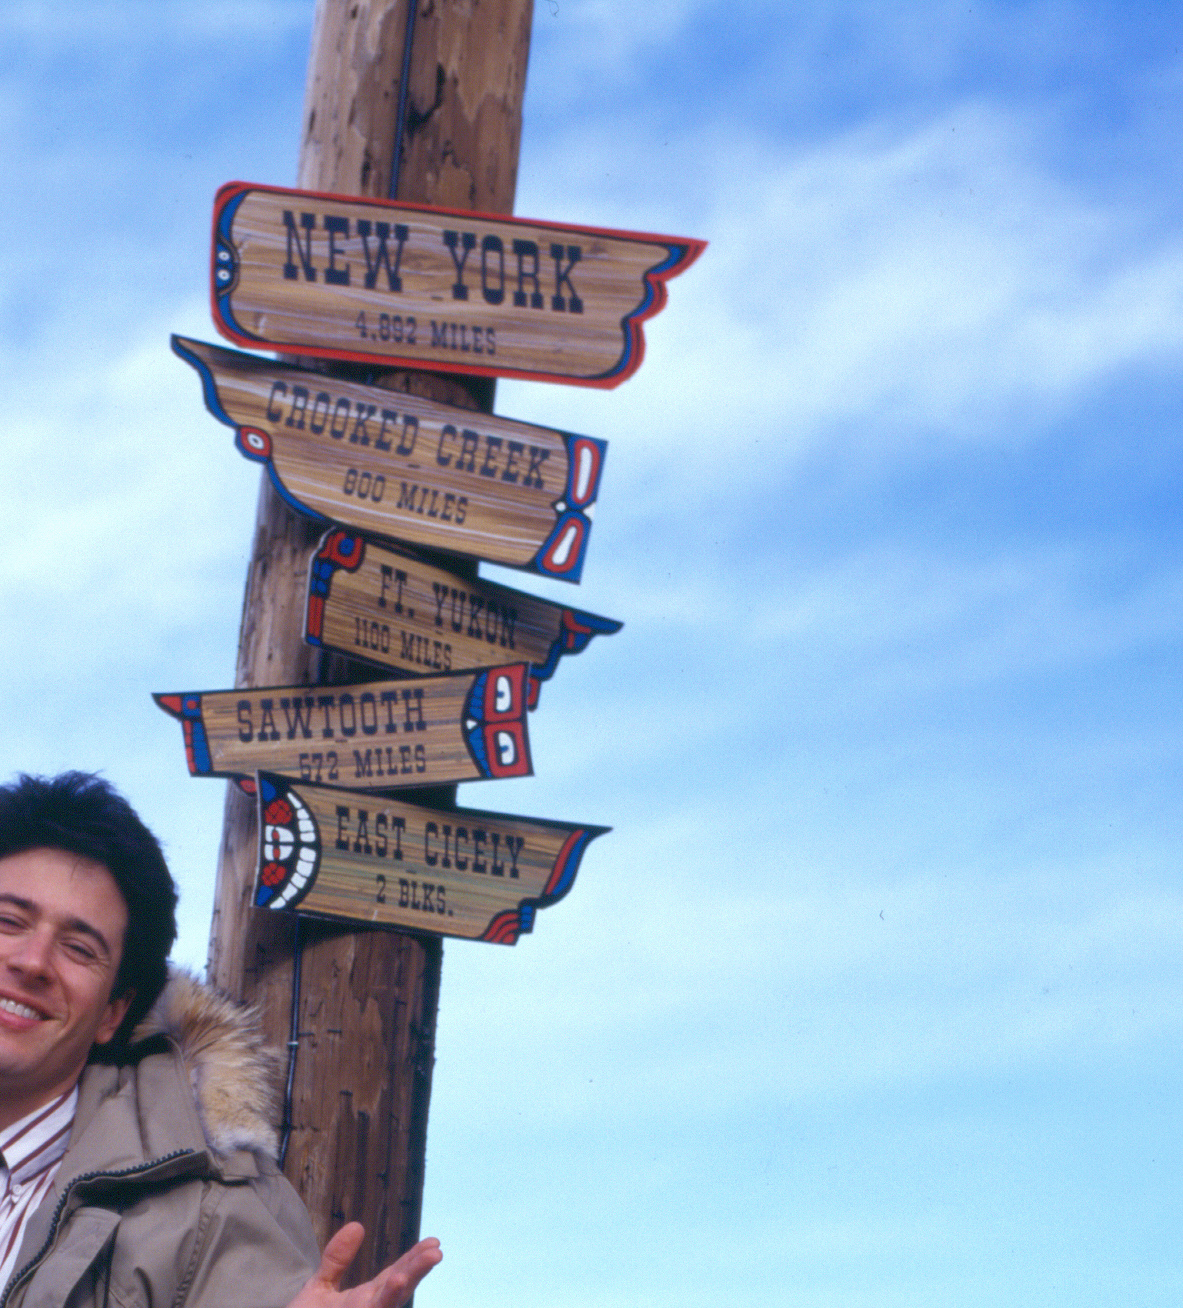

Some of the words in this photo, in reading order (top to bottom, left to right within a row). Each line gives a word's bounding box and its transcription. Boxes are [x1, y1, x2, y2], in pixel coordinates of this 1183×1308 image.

[282, 210, 409, 292] NEW
[443, 229, 585, 314] YORK
[430, 320, 497, 355] MILES
[265, 381, 420, 457] CROOKED
[436, 425, 551, 490] CREEK
[343, 468, 386, 503] 800
[396, 481, 469, 524] MILES
[379, 564, 415, 618] FT.
[432, 581, 517, 650] YUKON
[354, 617, 391, 653] 1100
[400, 636, 452, 671] MILES
[236, 688, 427, 743] SAWTOOTH
[298, 751, 339, 782] 572
[352, 744, 427, 778] MILES
[335, 805, 406, 861] EAST
[424, 821, 525, 879] CICELY
[375, 874, 386, 905] 2
[398, 877, 454, 917] BLKS.
